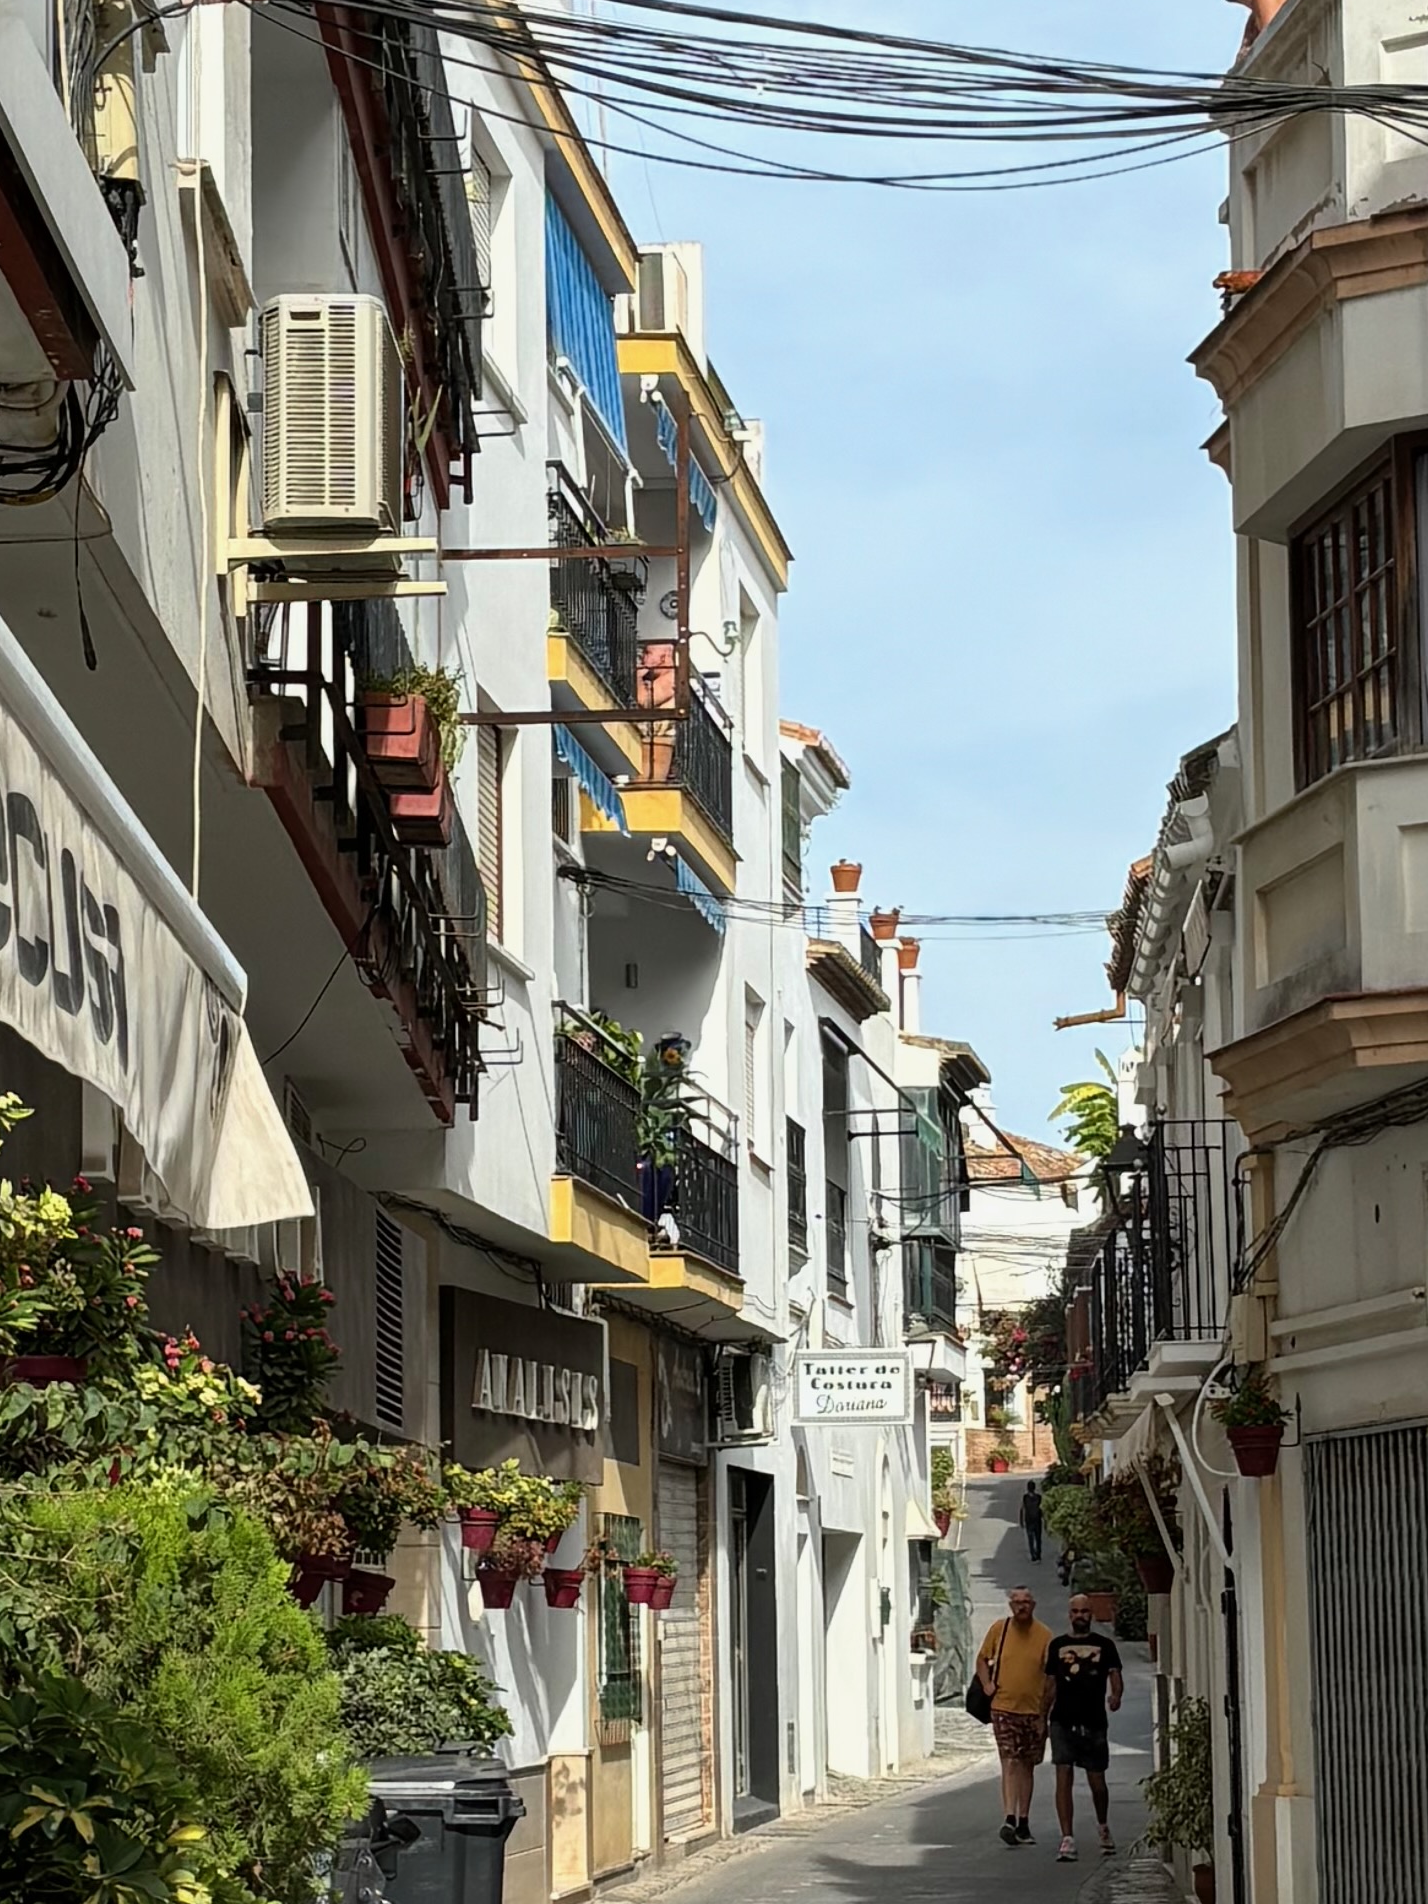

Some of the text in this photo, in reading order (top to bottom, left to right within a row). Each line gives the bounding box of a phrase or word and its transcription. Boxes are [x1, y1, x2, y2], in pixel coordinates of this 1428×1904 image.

[803, 1362, 900, 1376] Taller de
[810, 1377, 893, 1390] Costura
